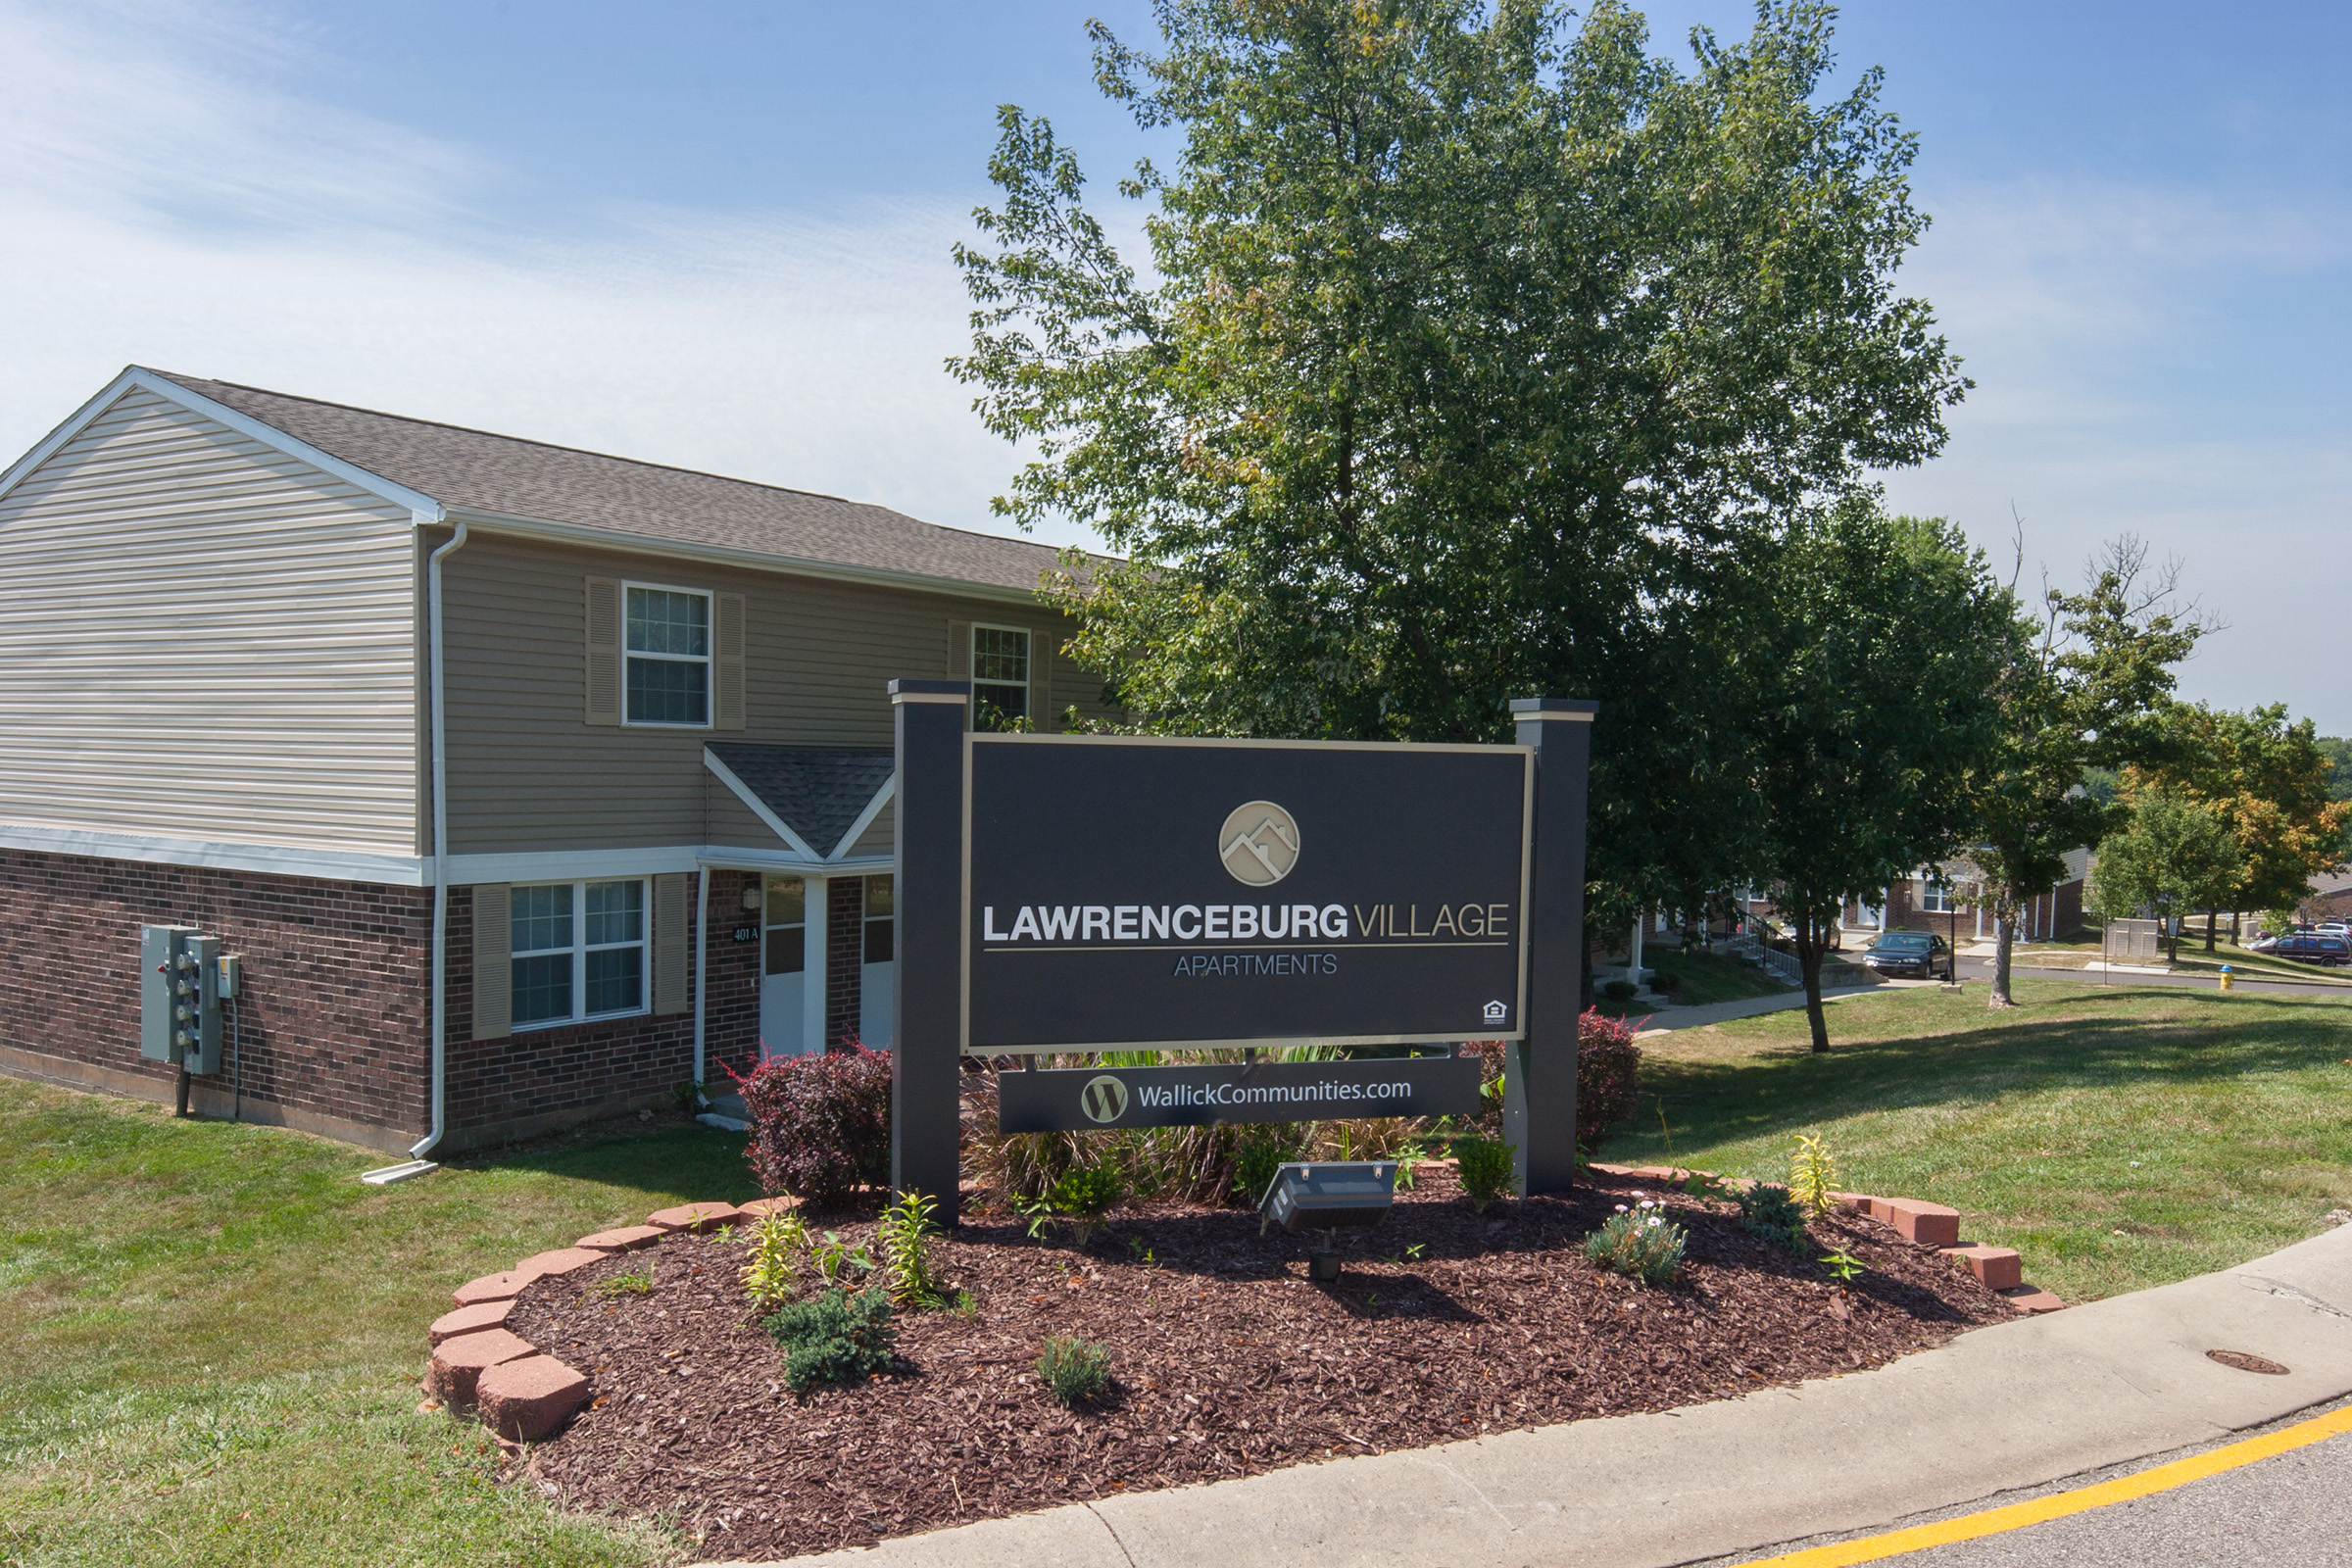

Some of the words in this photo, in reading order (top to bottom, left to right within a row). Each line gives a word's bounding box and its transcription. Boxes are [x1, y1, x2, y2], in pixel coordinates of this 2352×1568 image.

[734, 928, 750, 941] 401
[751, 927, 759, 940] A
[983, 904, 1348, 941] LAWRENCEBURG
[1353, 904, 1509, 937] VILLAGE
[1173, 954, 1338, 977] APARTMENTS
[1138, 1080, 1411, 1107] WallickCommunities.com
